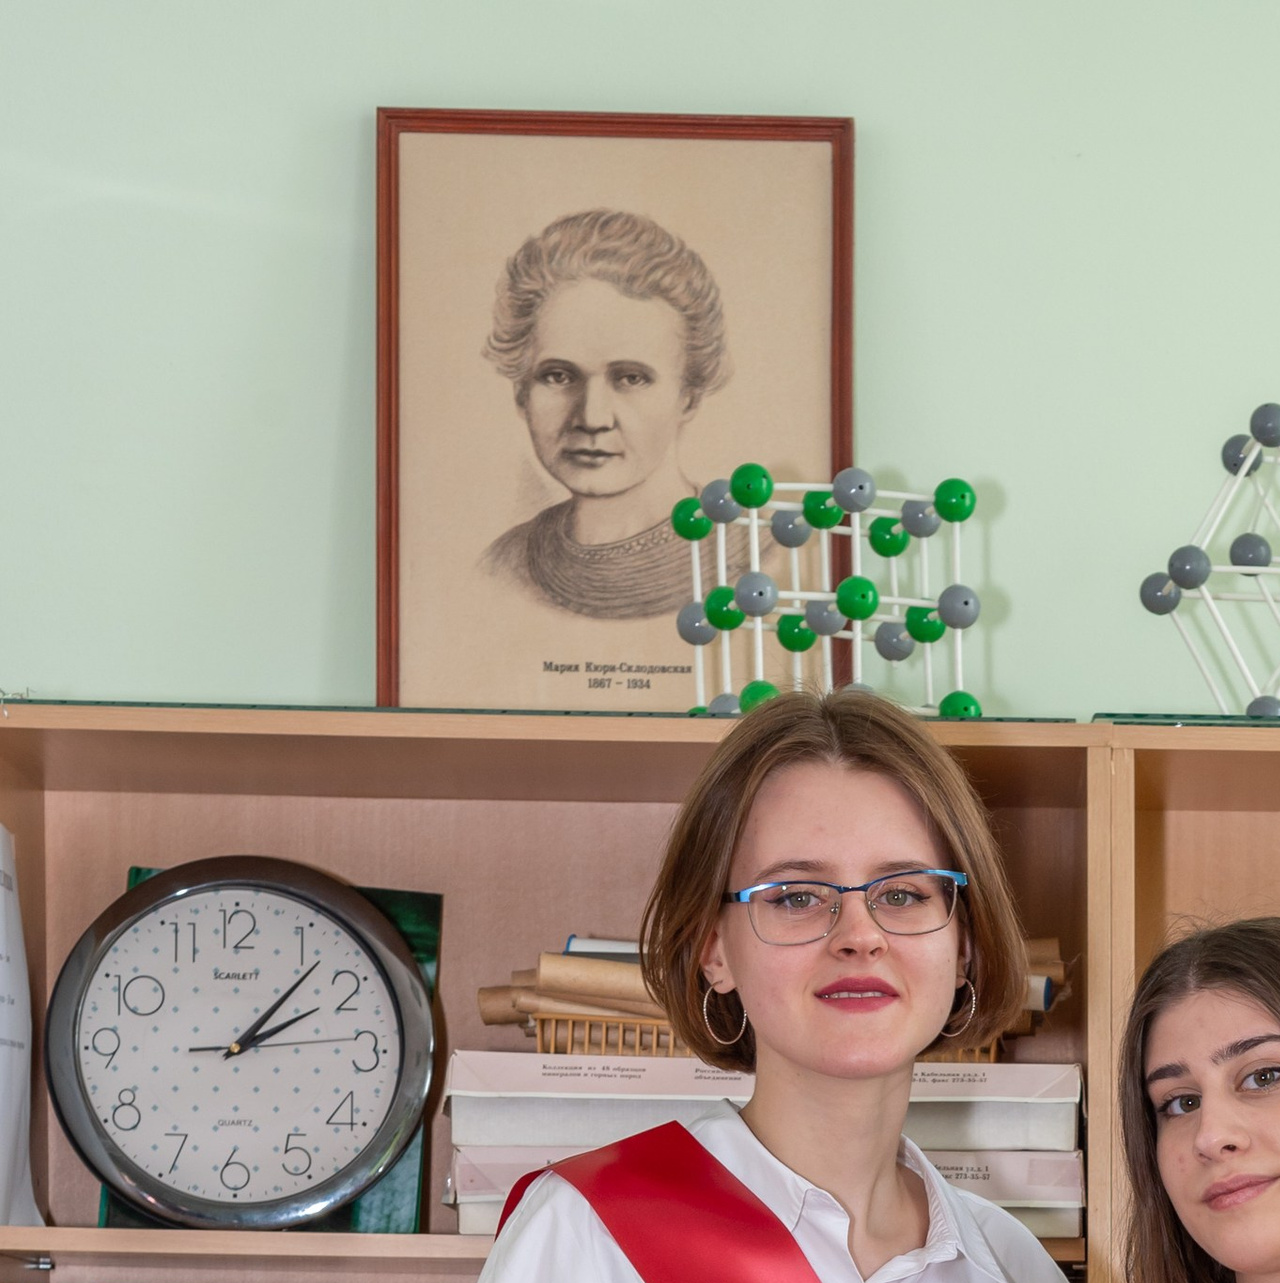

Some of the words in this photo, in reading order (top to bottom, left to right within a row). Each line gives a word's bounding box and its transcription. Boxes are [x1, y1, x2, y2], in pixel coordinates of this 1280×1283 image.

[543, 661, 580, 675] Мария
[584, 660, 693, 675] Кюри-Склодовская
[587, 678, 612, 690] 1867
[626, 678, 651, 690] 1934
[169, 921, 197, 964] 11
[219, 909, 258, 950] 12
[295, 926, 305, 966] 1
[114, 974, 165, 1017] 10
[213, 970, 260, 981] SCARLETT
[331, 970, 360, 1012] 2
[92, 1028, 121, 1070] 9
[351, 1029, 381, 1073] 3
[112, 1088, 141, 1132] 8
[217, 1119, 254, 1128] QUARTZ
[325, 1090, 358, 1132] 4
[164, 1133, 189, 1175] 7
[219, 1148, 251, 1191] 6
[282, 1133, 312, 1176] 5
